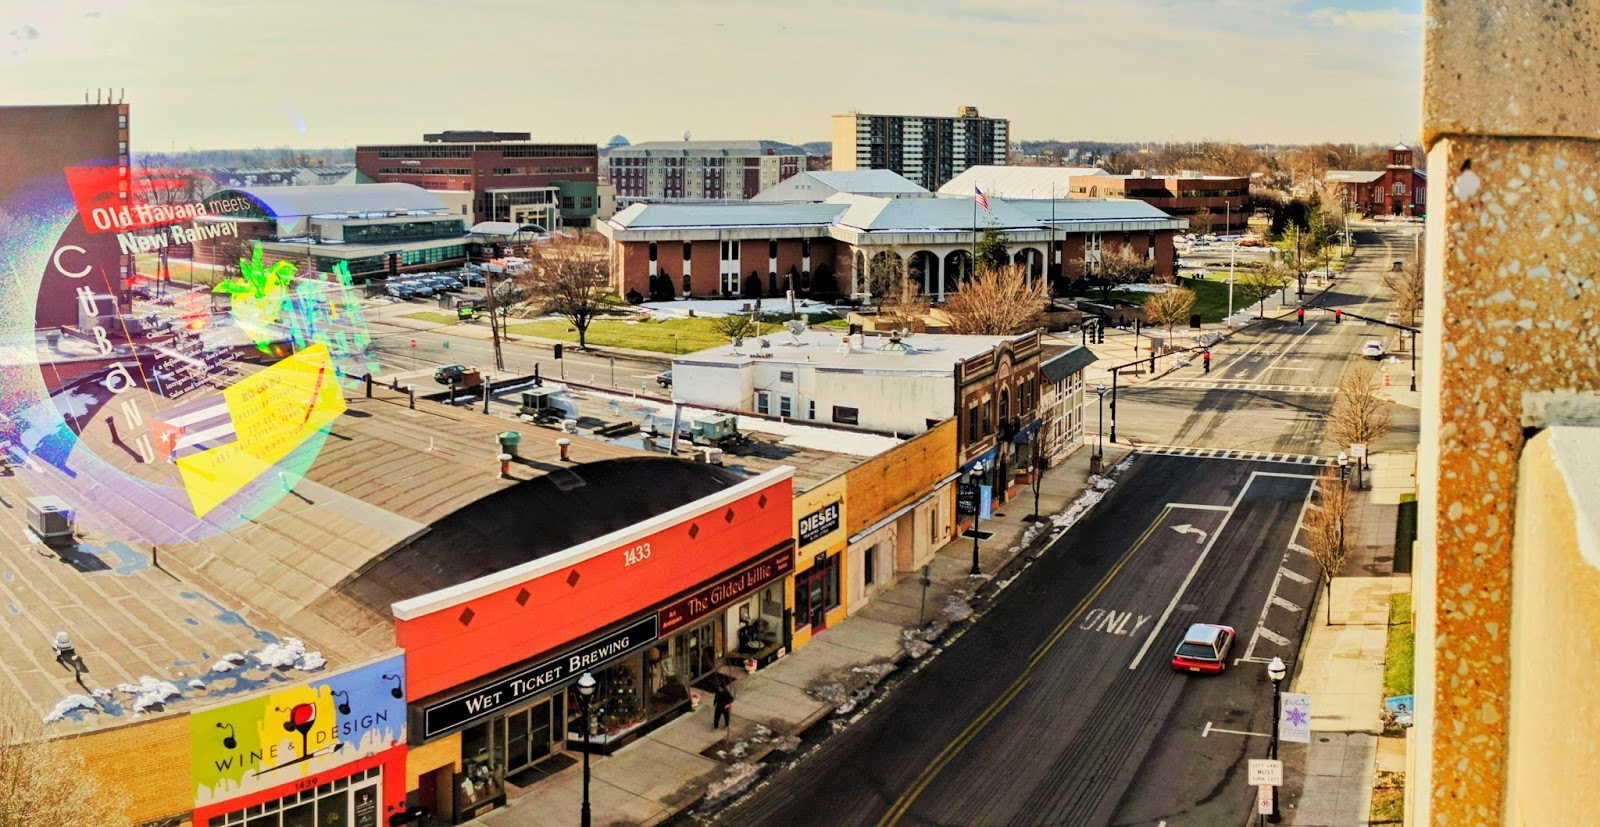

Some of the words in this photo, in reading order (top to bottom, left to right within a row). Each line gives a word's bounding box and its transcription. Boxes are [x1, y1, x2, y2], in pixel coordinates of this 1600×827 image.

[800, 505, 838, 536] DIESEL
[623, 543, 651, 568] 1433
[688, 596, 708, 616] The
[711, 575, 745, 604] Gilded
[747, 564, 771, 587] Lillie
[1079, 608, 1152, 637] ONLY
[465, 691, 503, 715] WET
[510, 666, 563, 697] TICKET
[569, 636, 630, 673] BREWING
[215, 743, 279, 772] WINE
[287, 742, 296, 751] &
[316, 710, 388, 744] DESIGN
[295, 777, 318, 791] 1439
